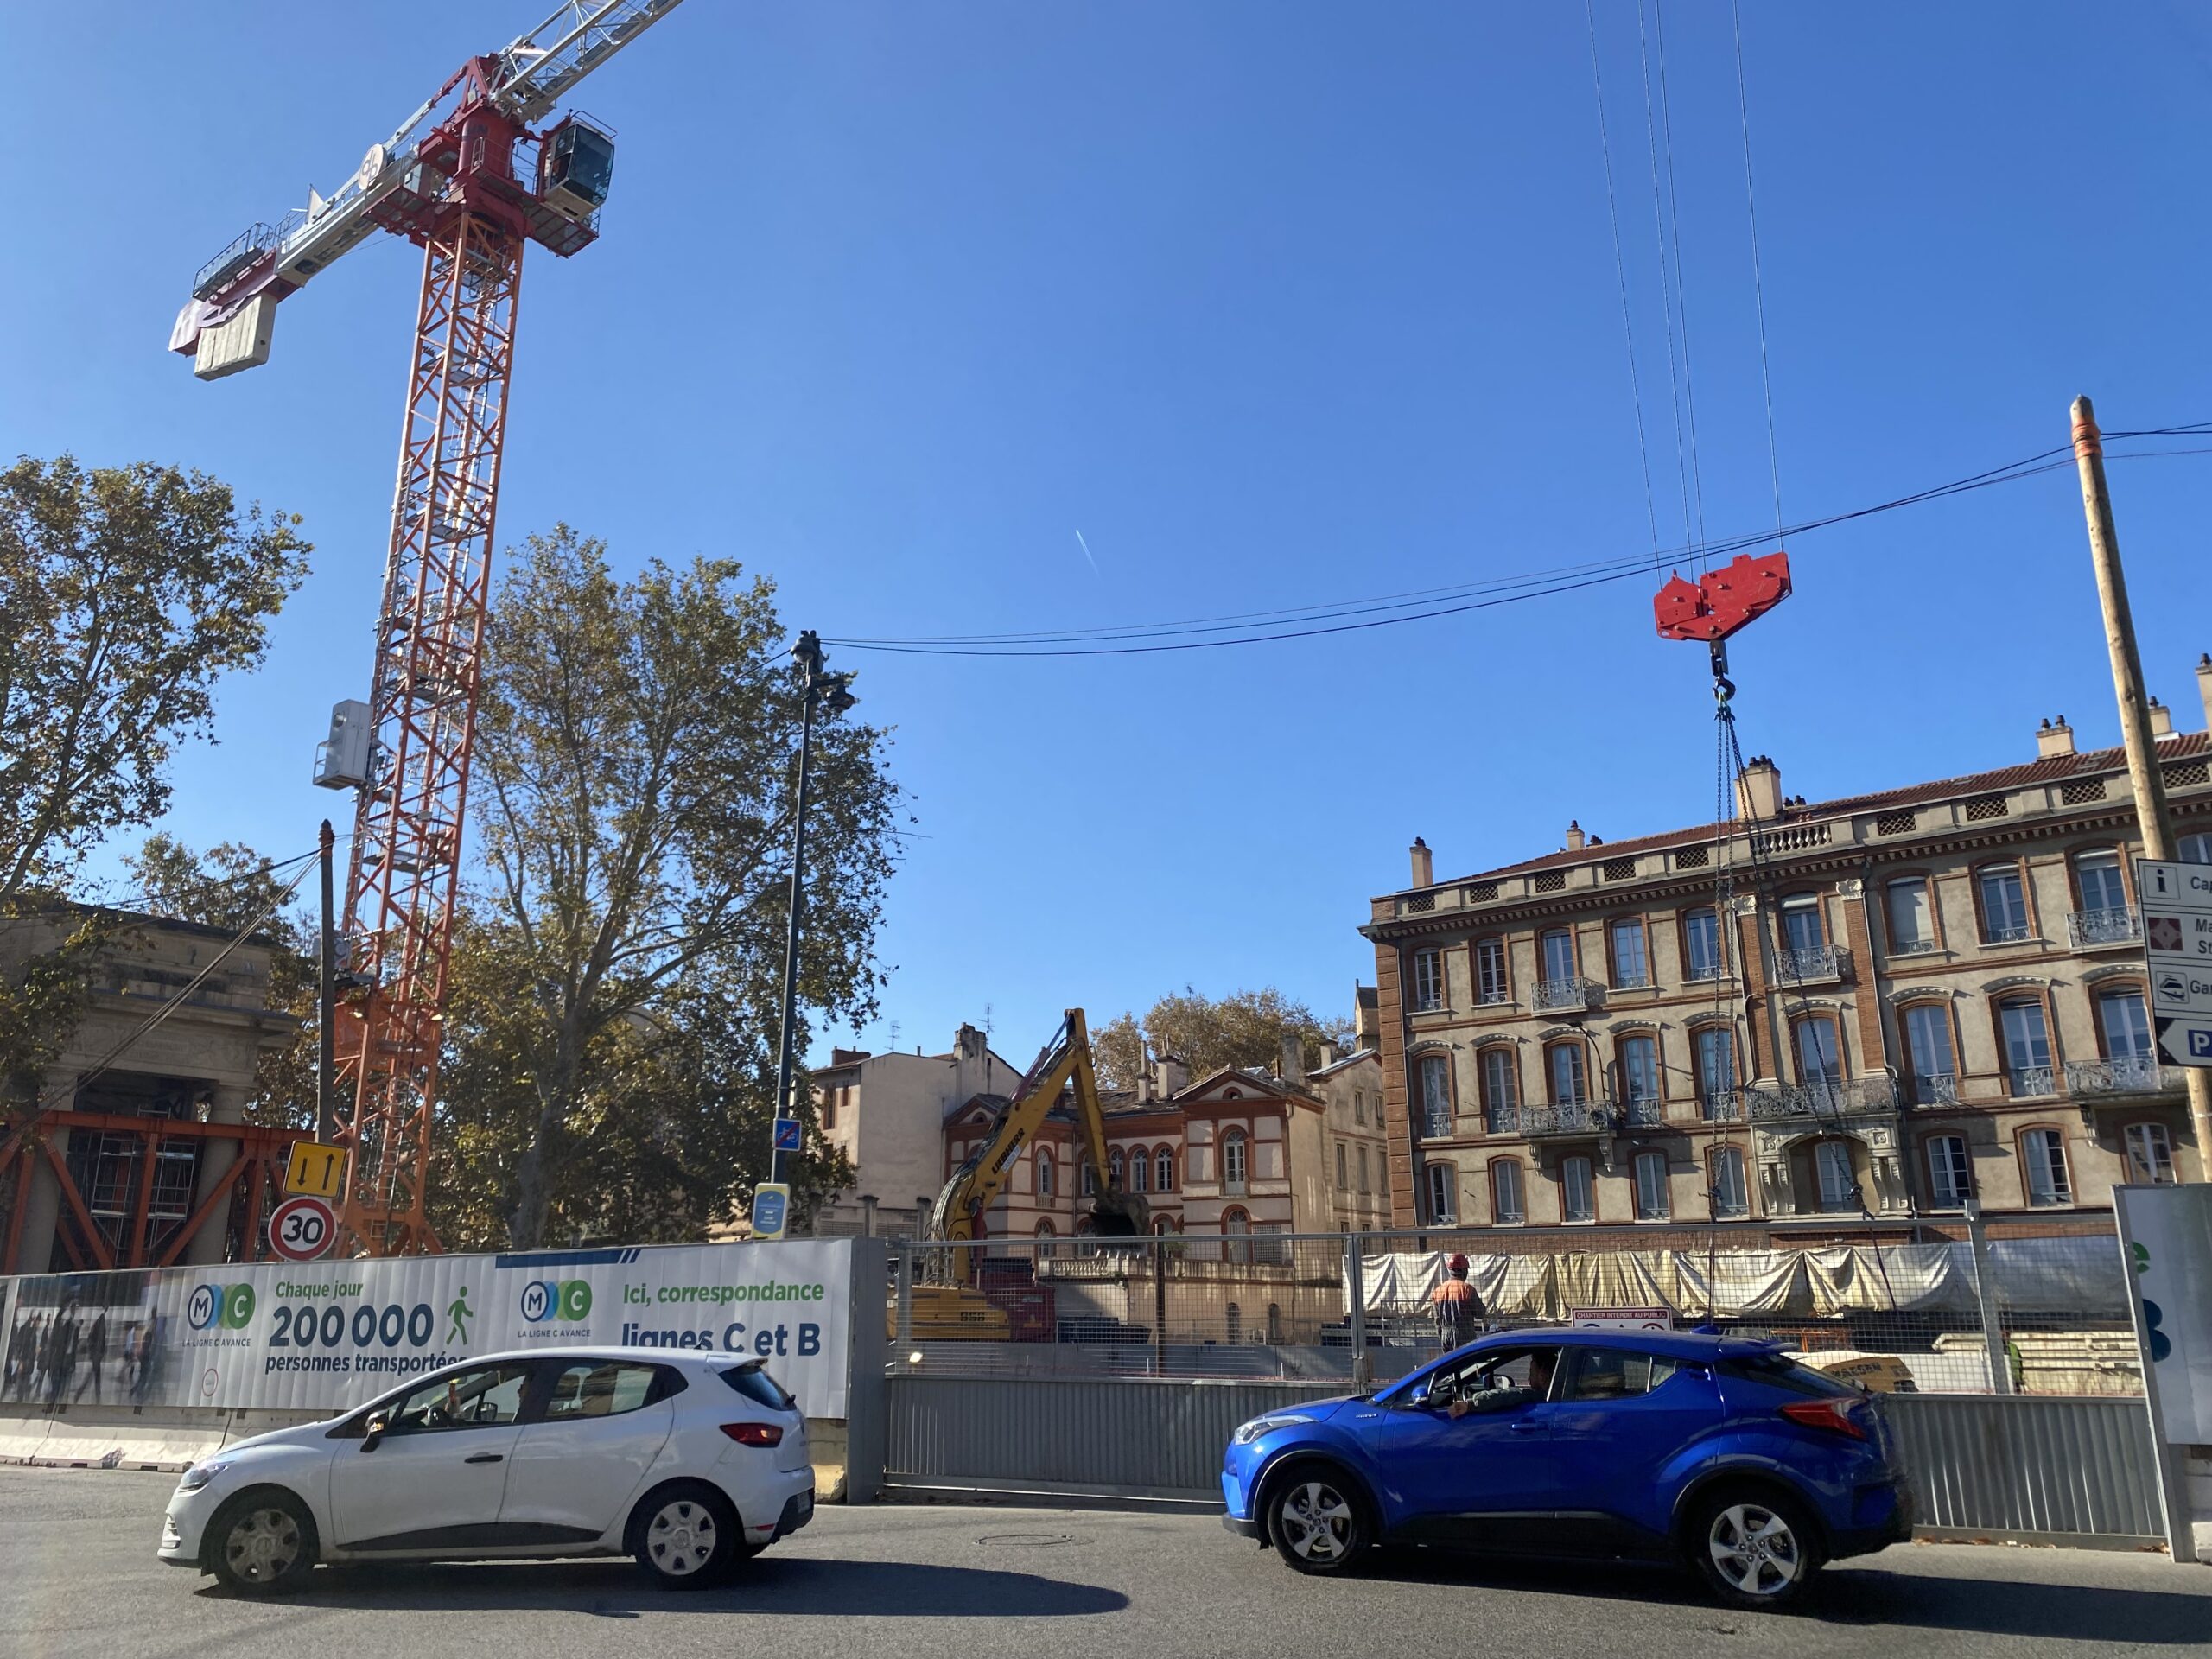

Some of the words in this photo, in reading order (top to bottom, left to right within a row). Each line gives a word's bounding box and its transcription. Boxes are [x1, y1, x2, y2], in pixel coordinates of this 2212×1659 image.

[2192, 1032, 2210, 1054] P
[283, 1214, 324, 1244] 30
[276, 1281, 330, 1300] Chaque
[333, 1281, 364, 1300] jour
[527, 1292, 543, 1312] M
[570, 1290, 584, 1312] C
[623, 1282, 652, 1307] Ici,
[657, 1280, 825, 1306] correspondance
[193, 1296, 209, 1319] M
[233, 1295, 248, 1319] C
[269, 1305, 345, 1348] 200
[351, 1303, 435, 1348] 000
[518, 1330, 527, 1338] LA
[529, 1329, 551, 1338] LIGNE
[552, 1329, 558, 1338] C
[560, 1329, 591, 1338] AVANCE
[181, 1338, 191, 1348] LA
[192, 1338, 213, 1348] LIGNE
[213, 1338, 220, 1347] C
[221, 1338, 251, 1347] AVANCE
[621, 1323, 714, 1351] lignes
[722, 1322, 747, 1354] C
[754, 1324, 789, 1357] et
[797, 1322, 821, 1357] B
[265, 1354, 350, 1376] personnes
